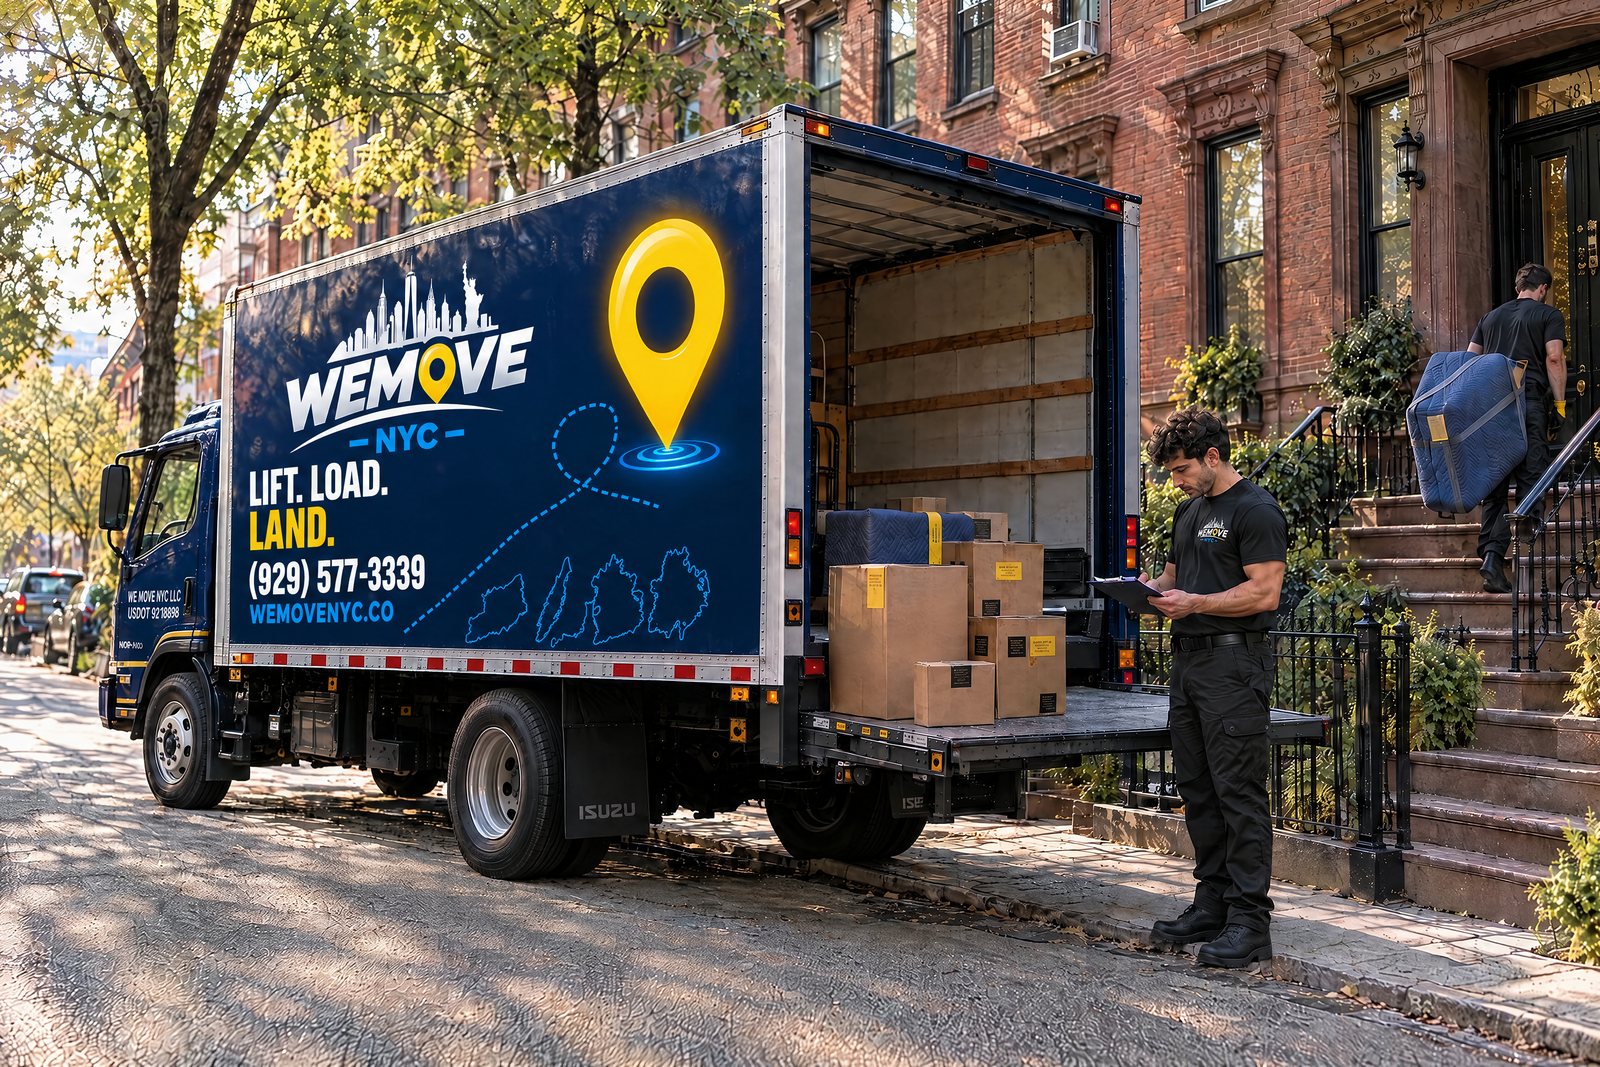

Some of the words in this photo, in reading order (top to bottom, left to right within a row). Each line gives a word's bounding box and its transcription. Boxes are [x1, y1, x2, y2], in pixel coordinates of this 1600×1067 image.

[286, 326, 534, 433] WEMOVE
[375, 422, 439, 454] NYC
[249, 465, 303, 506] LIFT.
[311, 459, 389, 503] LOAD.
[249, 506, 335, 551] LAND.
[249, 558, 310, 600] (929)
[317, 554, 425, 594] 577-3339
[127, 590, 138, 603] WE
[138, 590, 155, 603] MOVE
[156, 590, 169, 602] NYC
[169, 589, 182, 602] LLC
[127, 607, 150, 620] USDOT
[249, 600, 394, 625] WEMOVENYC.CO
[578, 802, 636, 820] ISUZU
